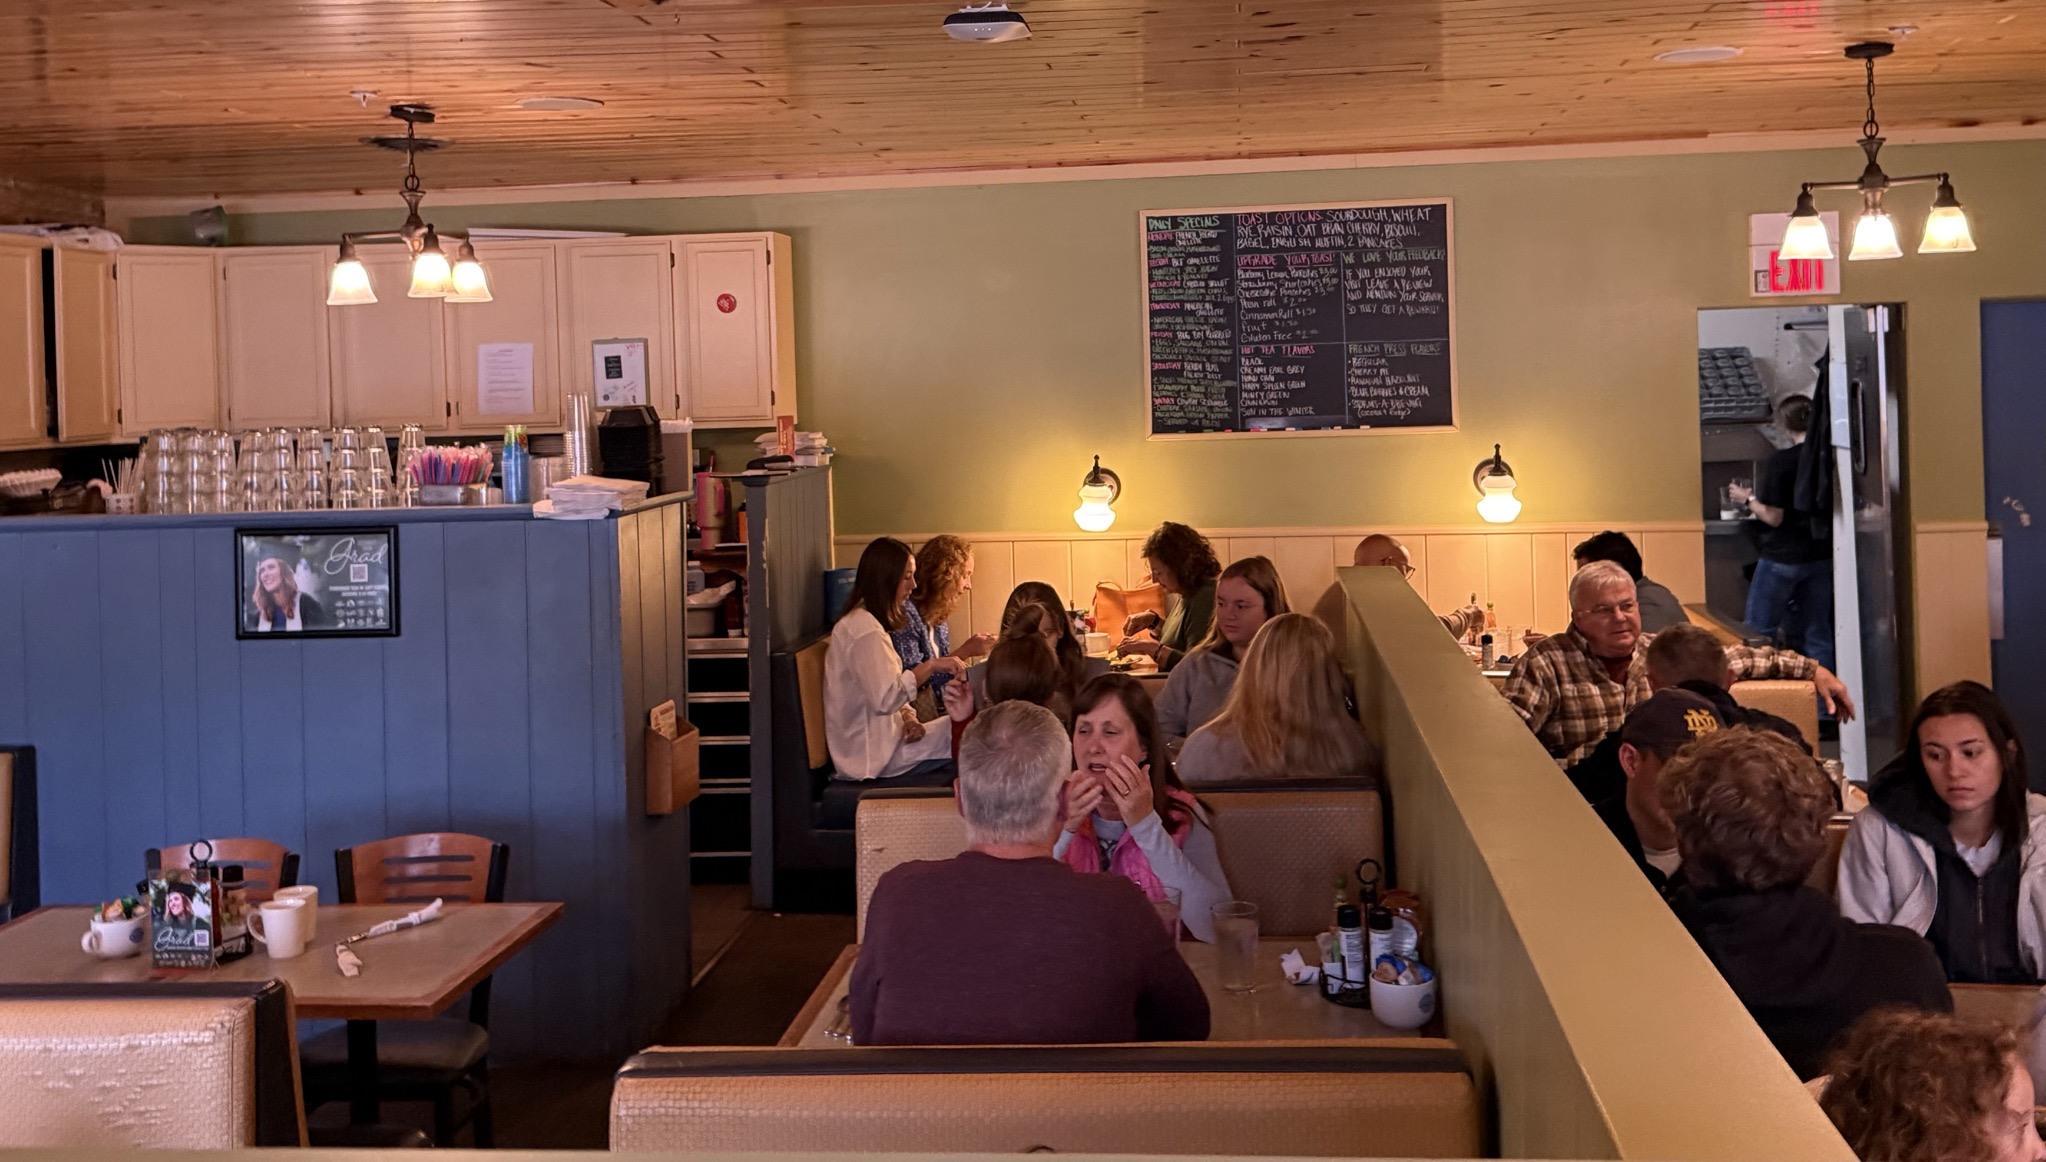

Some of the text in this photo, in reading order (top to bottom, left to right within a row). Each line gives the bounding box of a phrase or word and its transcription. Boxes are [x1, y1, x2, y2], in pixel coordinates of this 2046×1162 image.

[1148, 216, 1220, 230] DAILY SPECIALS
[1236, 212, 1268, 226] TOAST
[1297, 224, 1317, 237] OAT
[1322, 222, 1344, 235] BRAN
[1236, 237, 1270, 249] BAGEL,
[1272, 237, 1312, 248] ENGLISH
[1348, 236, 1354, 246] 2
[1358, 236, 1403, 249] PANCAKES
[1186, 255, 1220, 265] OMELETTE
[1237, 255, 1277, 266] UPGRADE
[1284, 254, 1310, 266] YOUR
[1343, 252, 1355, 264] WE
[1363, 252, 1382, 262] LOVE
[1386, 250, 1407, 262] YOUR
[1346, 266, 1431, 280] IF YOU ENJOYED YOUR
[1366, 278, 1390, 290] LEAVE
[1394, 279, 1400, 290] A
[1400, 278, 1432, 290] REVIEW
[1346, 290, 1362, 300] AND
[1366, 290, 1397, 300] MENTION
[1398, 290, 1418, 302] YOUR
[1240, 310, 1278, 320] Cinnamon
[1278, 308, 1294, 320] Roll
[1346, 303, 1356, 314] SO
[1360, 304, 1377, 313] THEY
[1382, 304, 1396, 314] GET
[1399, 304, 1406, 315] A
[1274, 331, 1292, 340] Free
[1241, 346, 1254, 354] HOT
[1261, 345, 1275, 354] TEA
[1282, 346, 1316, 356] FLAVORS
[1348, 343, 1440, 355] FRENCH PRESS FLAVORS
[1352, 357, 1388, 366] REGULAR
[1286, 365, 1305, 374] GREY
[1350, 368, 1378, 376] CHERRY
[1242, 392, 1264, 400] MINTY
[1404, 386, 1430, 396] CREAM
[1240, 408, 1256, 416] SUN
[1258, 408, 1266, 416] IN
[1269, 408, 1284, 416] THE
[1286, 406, 1316, 416] WINTER
[324, 537, 388, 574] Grad
[154, 926, 194, 951] Grad
